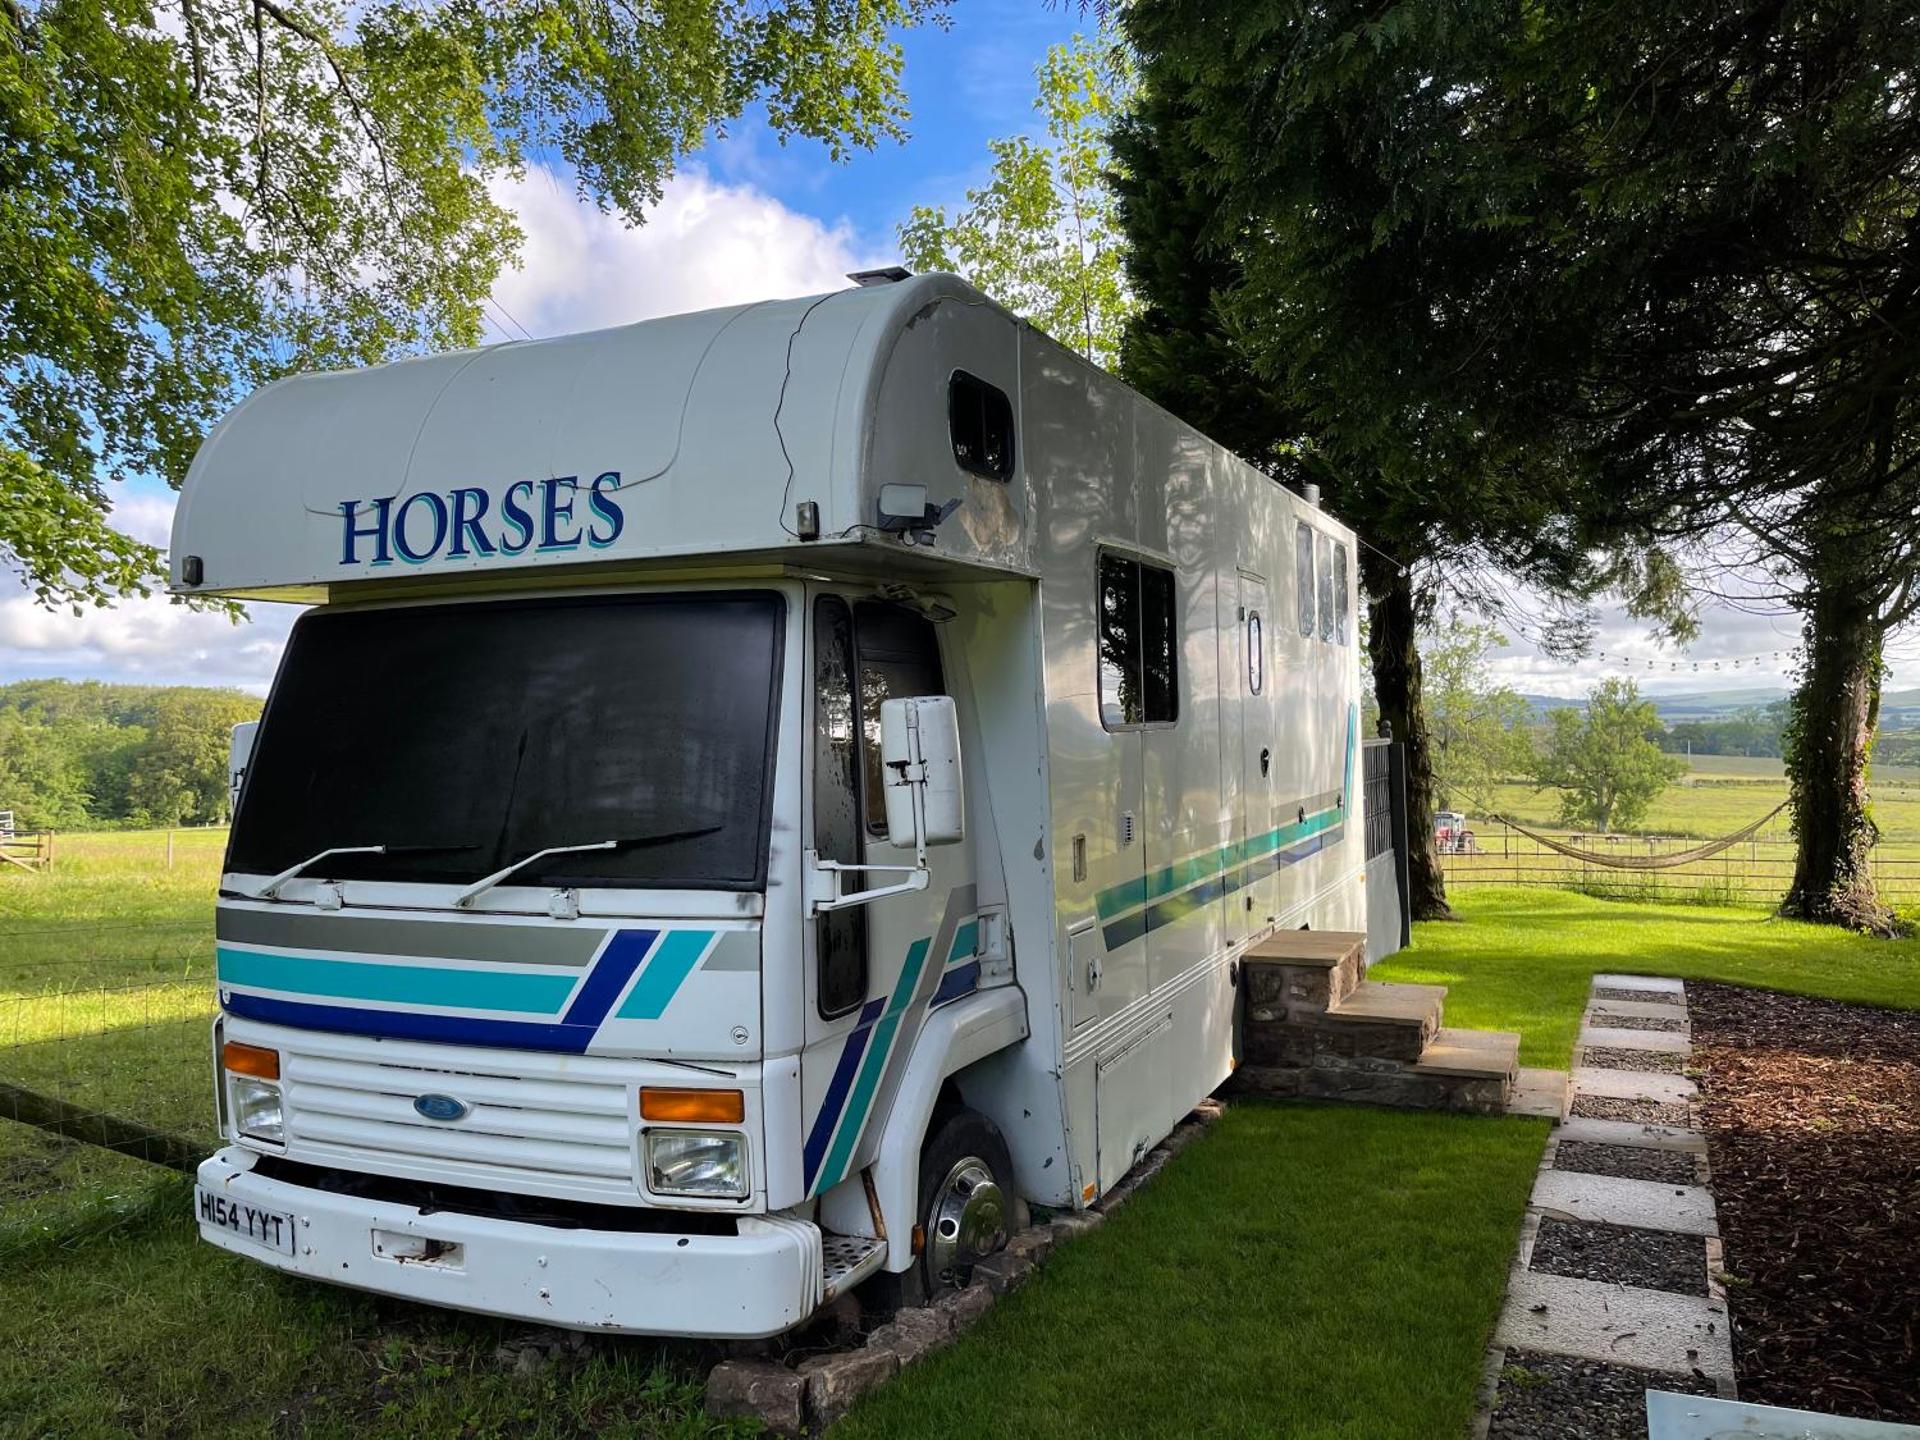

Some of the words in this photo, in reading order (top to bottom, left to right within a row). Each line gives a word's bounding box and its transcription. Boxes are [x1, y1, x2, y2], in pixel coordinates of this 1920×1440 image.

[338, 471, 624, 566] HORSES
[200, 1191, 239, 1231] H154
[244, 1206, 283, 1245] YYT
